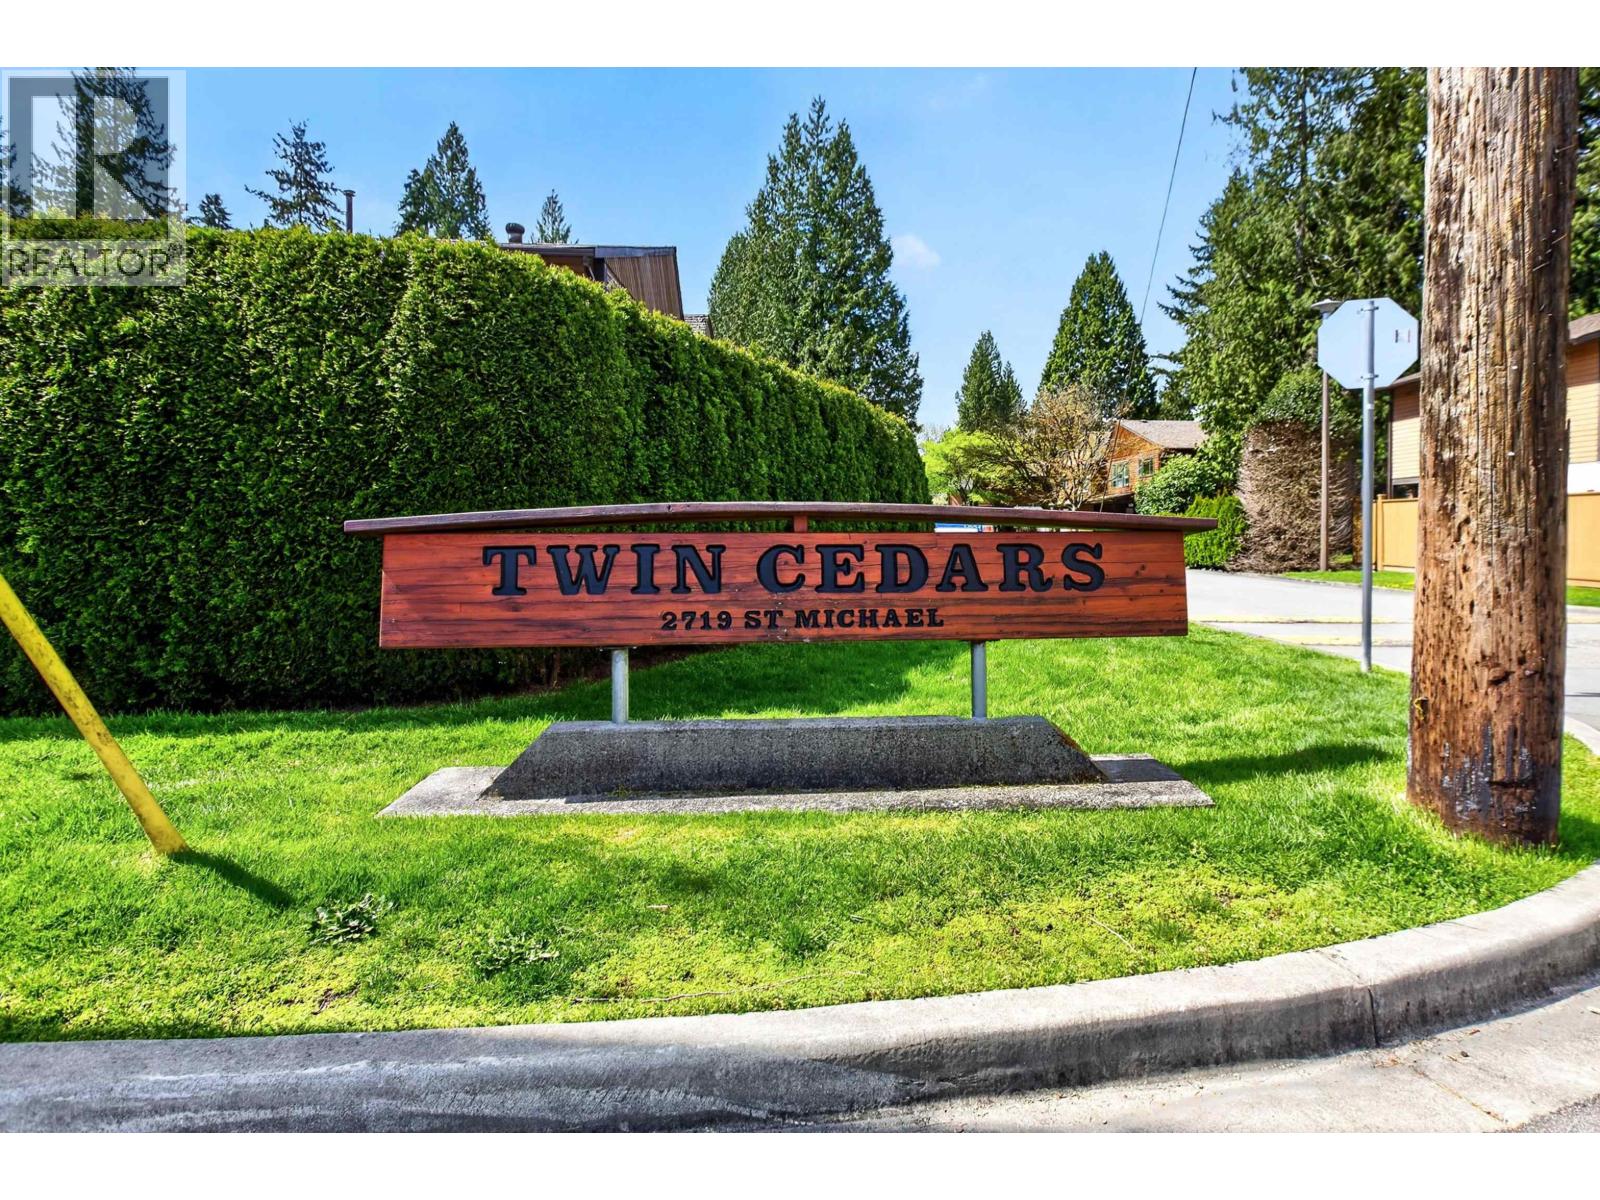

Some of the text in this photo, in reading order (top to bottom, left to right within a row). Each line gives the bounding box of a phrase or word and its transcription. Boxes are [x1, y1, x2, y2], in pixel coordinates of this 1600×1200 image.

[482, 543, 1105, 596] TWIN CEDARS
[661, 608, 945, 630] 2719 ST MICHAEL
